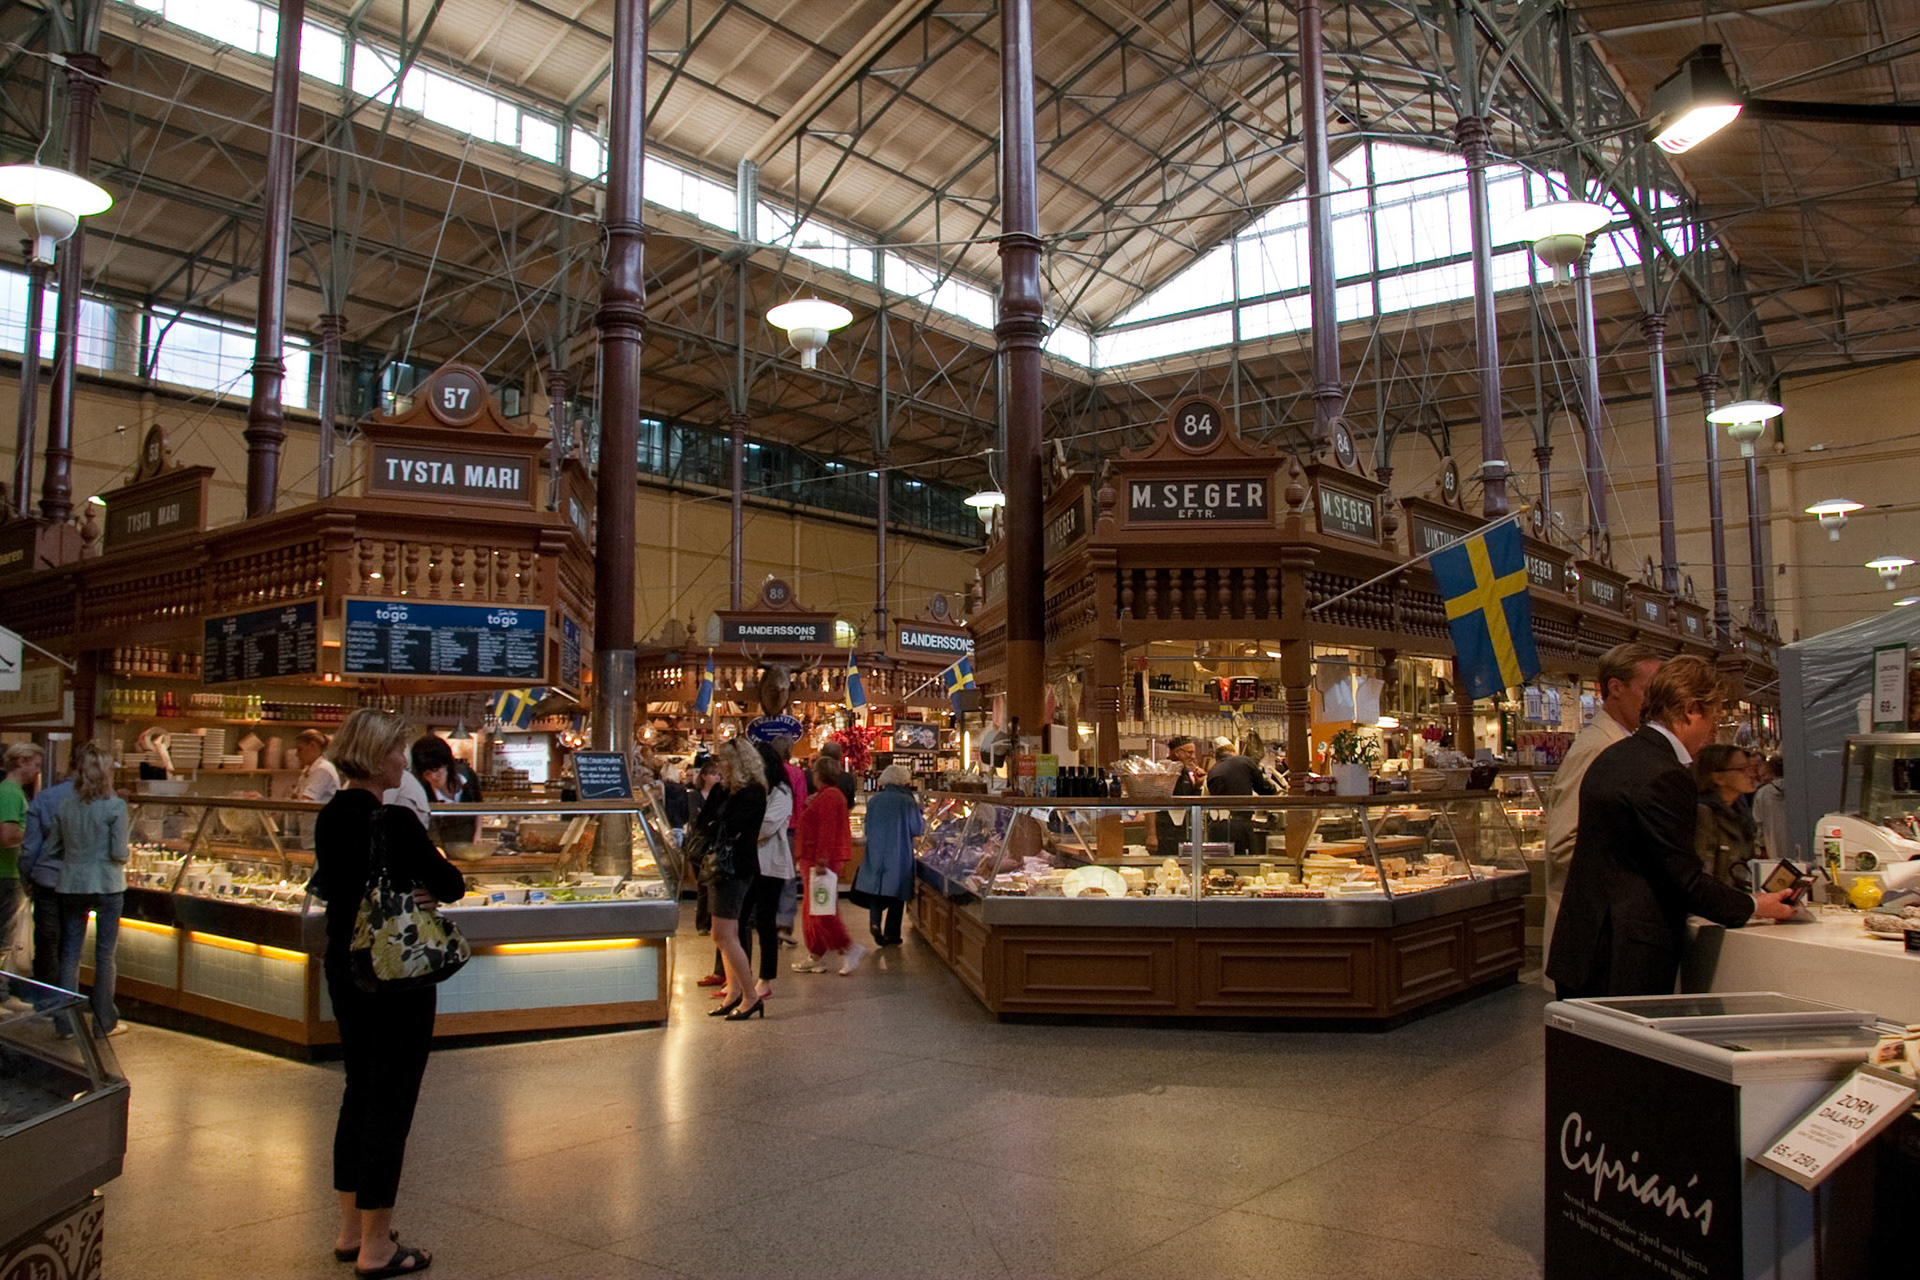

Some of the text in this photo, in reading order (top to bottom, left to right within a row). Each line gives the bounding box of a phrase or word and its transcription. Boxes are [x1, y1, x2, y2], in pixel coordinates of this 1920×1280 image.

[444, 388, 470, 409] 57
[1184, 414, 1212, 435] 84
[1337, 433, 1350, 456] 84
[386, 458, 520, 490] TYSTA MARI
[1444, 471, 1454, 491] 83
[127, 503, 180, 533] TYSTA MARI
[1178, 509, 1216, 518] EFTR.
[769, 588, 785, 600] 88
[1836, 1094, 1879, 1116] ZORN
[1818, 1107, 1867, 1130] DALARÖ
